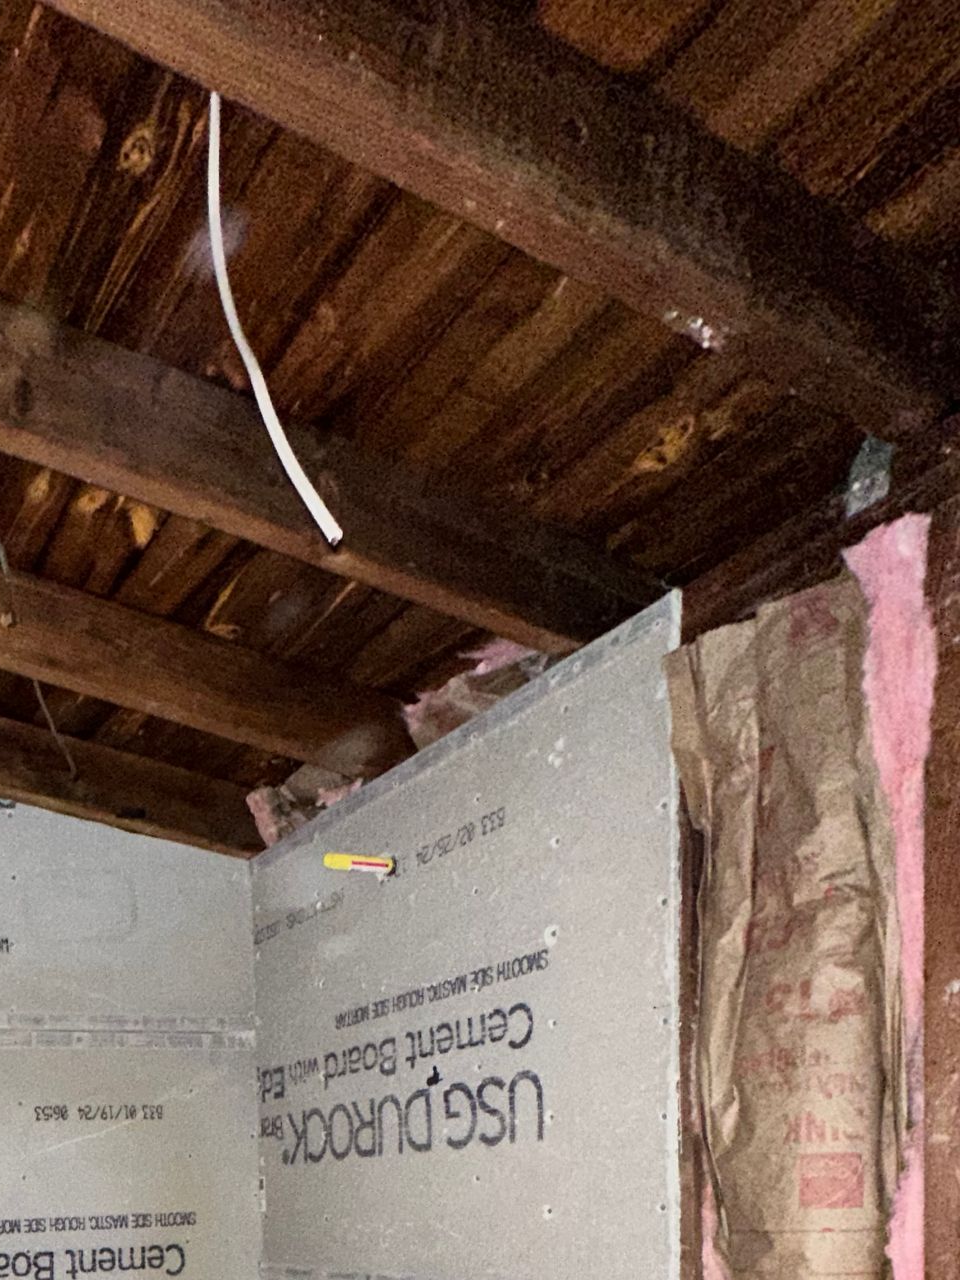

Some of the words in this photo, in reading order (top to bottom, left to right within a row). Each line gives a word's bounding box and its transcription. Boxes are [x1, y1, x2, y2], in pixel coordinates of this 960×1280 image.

[405, 1002, 534, 1071] Cement
[323, 1037, 396, 1090] Board
[288, 1058, 321, 1088] with
[34, 1105, 69, 1121] 06:53
[77, 1104, 137, 1121] 01/19/24
[443, 1069, 545, 1150] USG
[23, 1218, 47, 1234] SIDE
[49, 1216, 86, 1231] ROUGH
[131, 1213, 153, 1228] SIDE
[155, 1211, 197, 1227] SMOOTH
[65, 1243, 187, 1277] Cement
